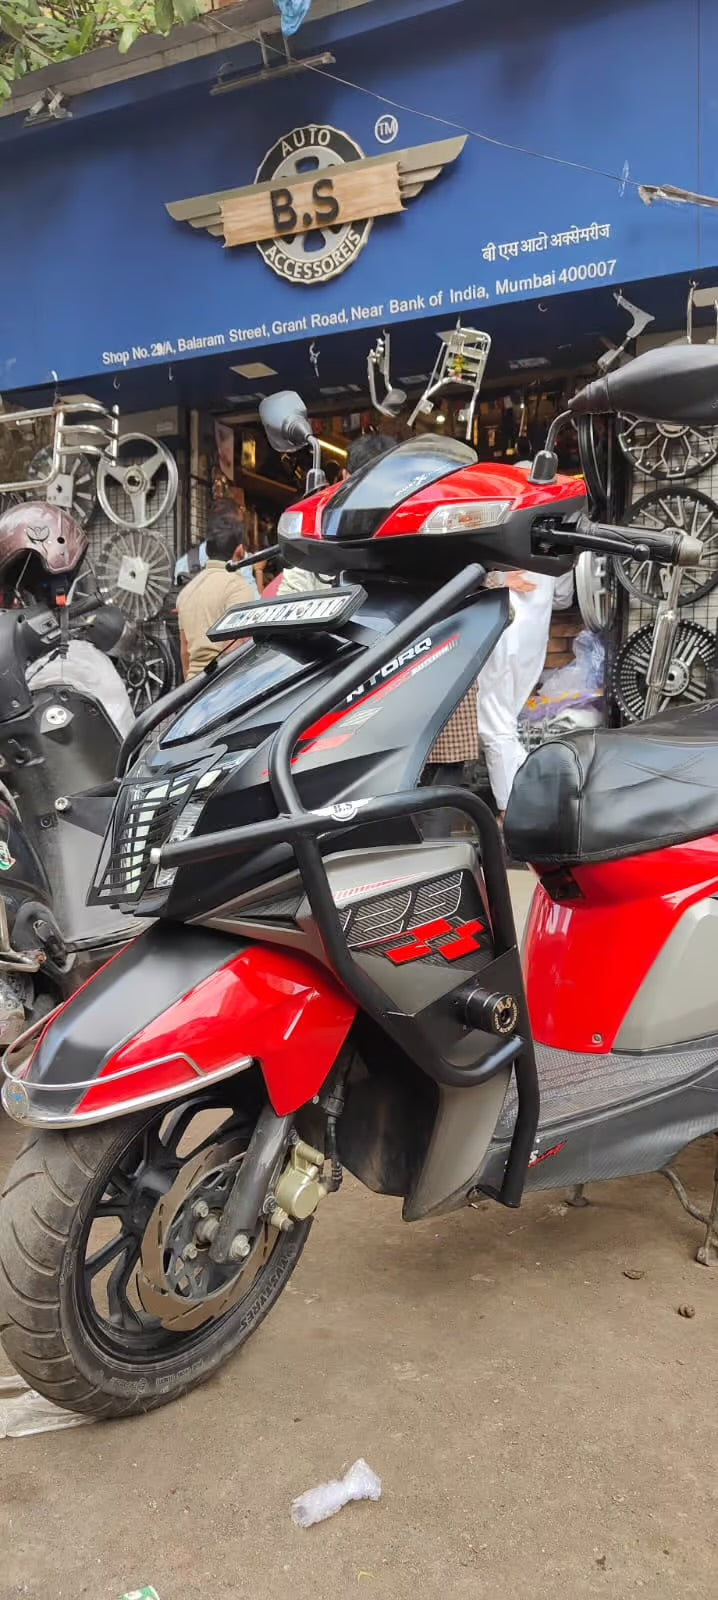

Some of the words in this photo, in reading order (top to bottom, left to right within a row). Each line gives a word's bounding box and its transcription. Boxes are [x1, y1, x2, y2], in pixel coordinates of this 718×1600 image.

[282, 127, 331, 157] AUTO
[378, 121, 396, 137] TM
[270, 178, 339, 233] B.S
[264, 229, 361, 279] ACCESSOREIS
[481, 242, 497, 262] बी
[498, 241, 519, 261] एस
[520, 231, 549, 253] आटो
[102, 351, 130, 366] Shop
[178, 333, 225, 352] Balaram
[229, 323, 270, 343] Street,
[272, 317, 307, 335] Grant
[311, 308, 349, 328] Road,
[351, 304, 384, 321] Near
[389, 295, 425, 314] Bank
[429, 290, 443, 307] of
[450, 284, 490, 303] India,
[495, 270, 556, 296] Mumbai
[558, 259, 617, 284] 400007
[346, 637, 432, 704] NTORQ
